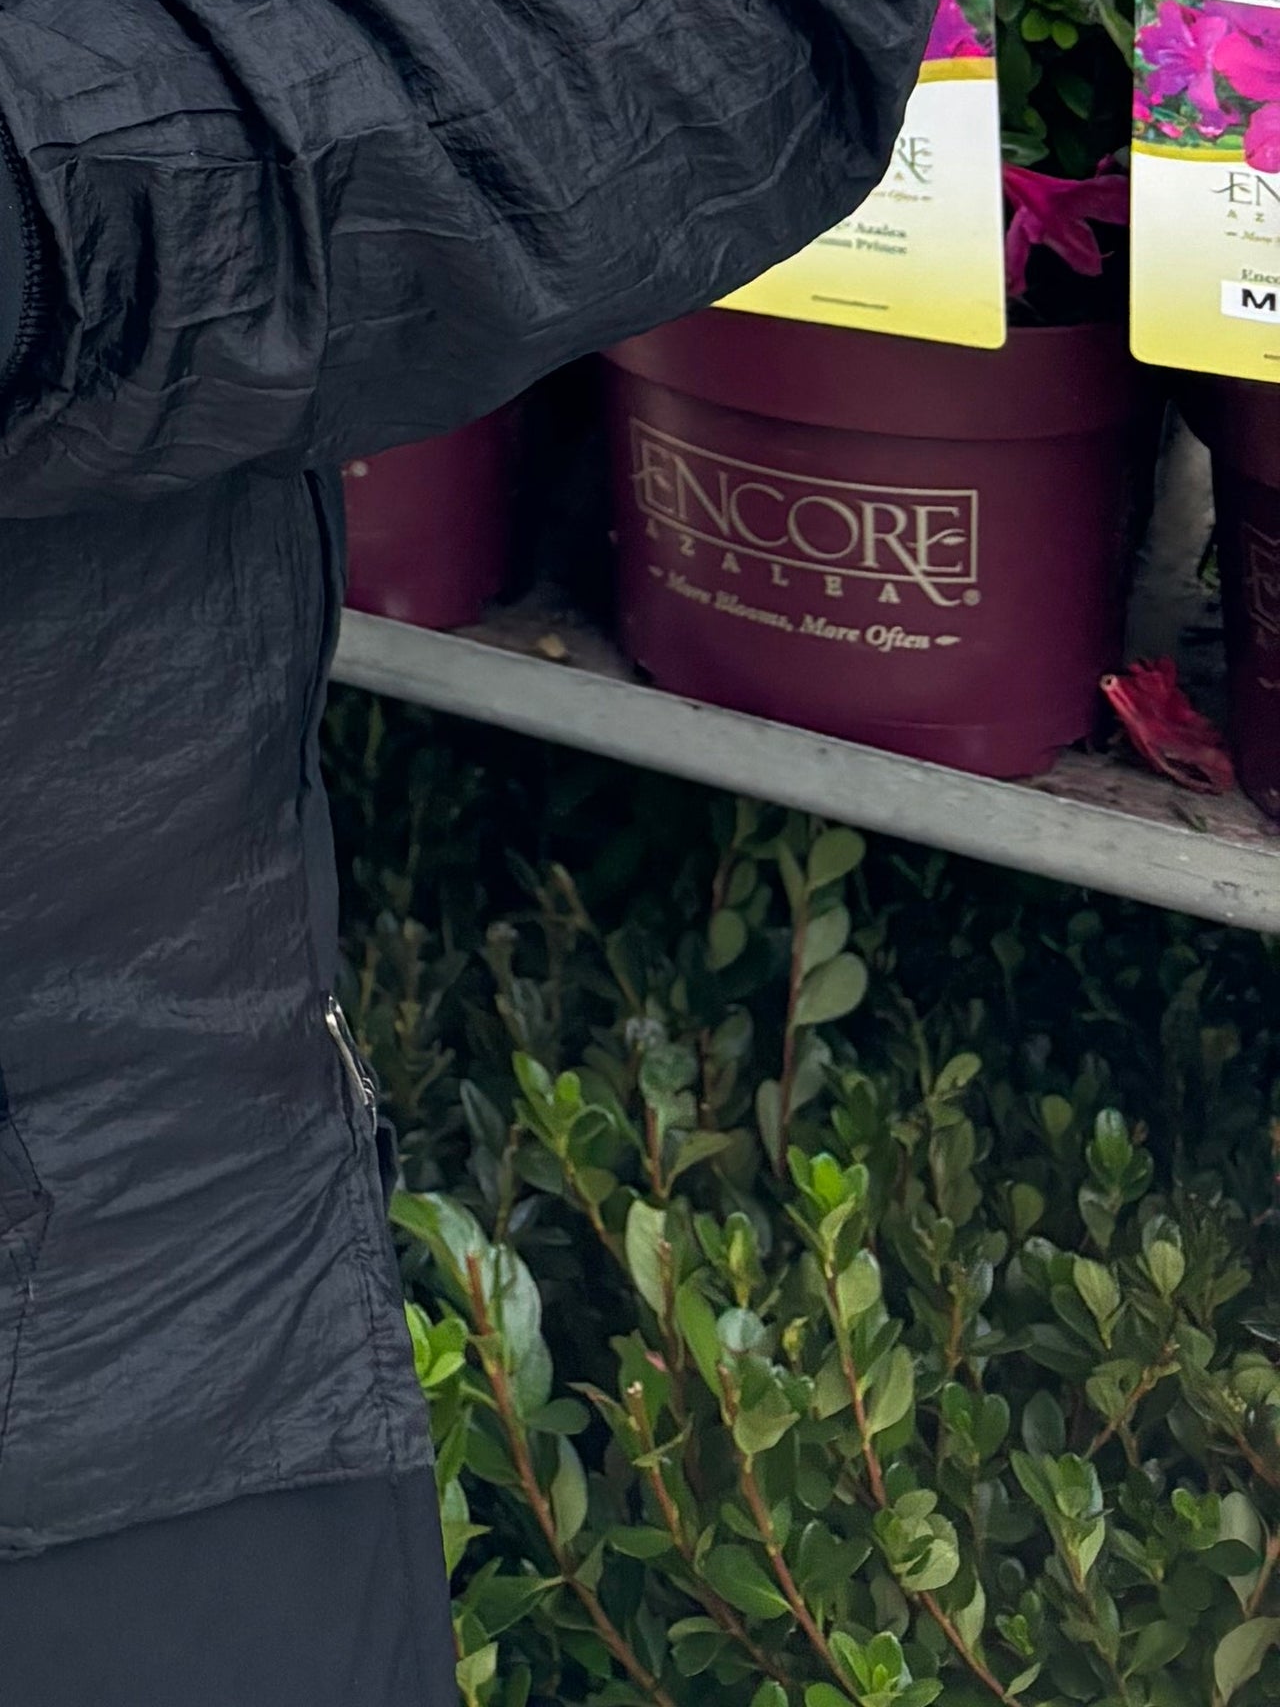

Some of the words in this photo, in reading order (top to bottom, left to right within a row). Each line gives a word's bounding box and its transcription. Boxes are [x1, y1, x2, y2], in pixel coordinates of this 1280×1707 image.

[636, 441, 966, 606] ENCORE
[646, 518, 901, 605] AZALEA
[665, 569, 711, 604] More
[799, 614, 861, 643] More
[865, 624, 931, 653] Often
